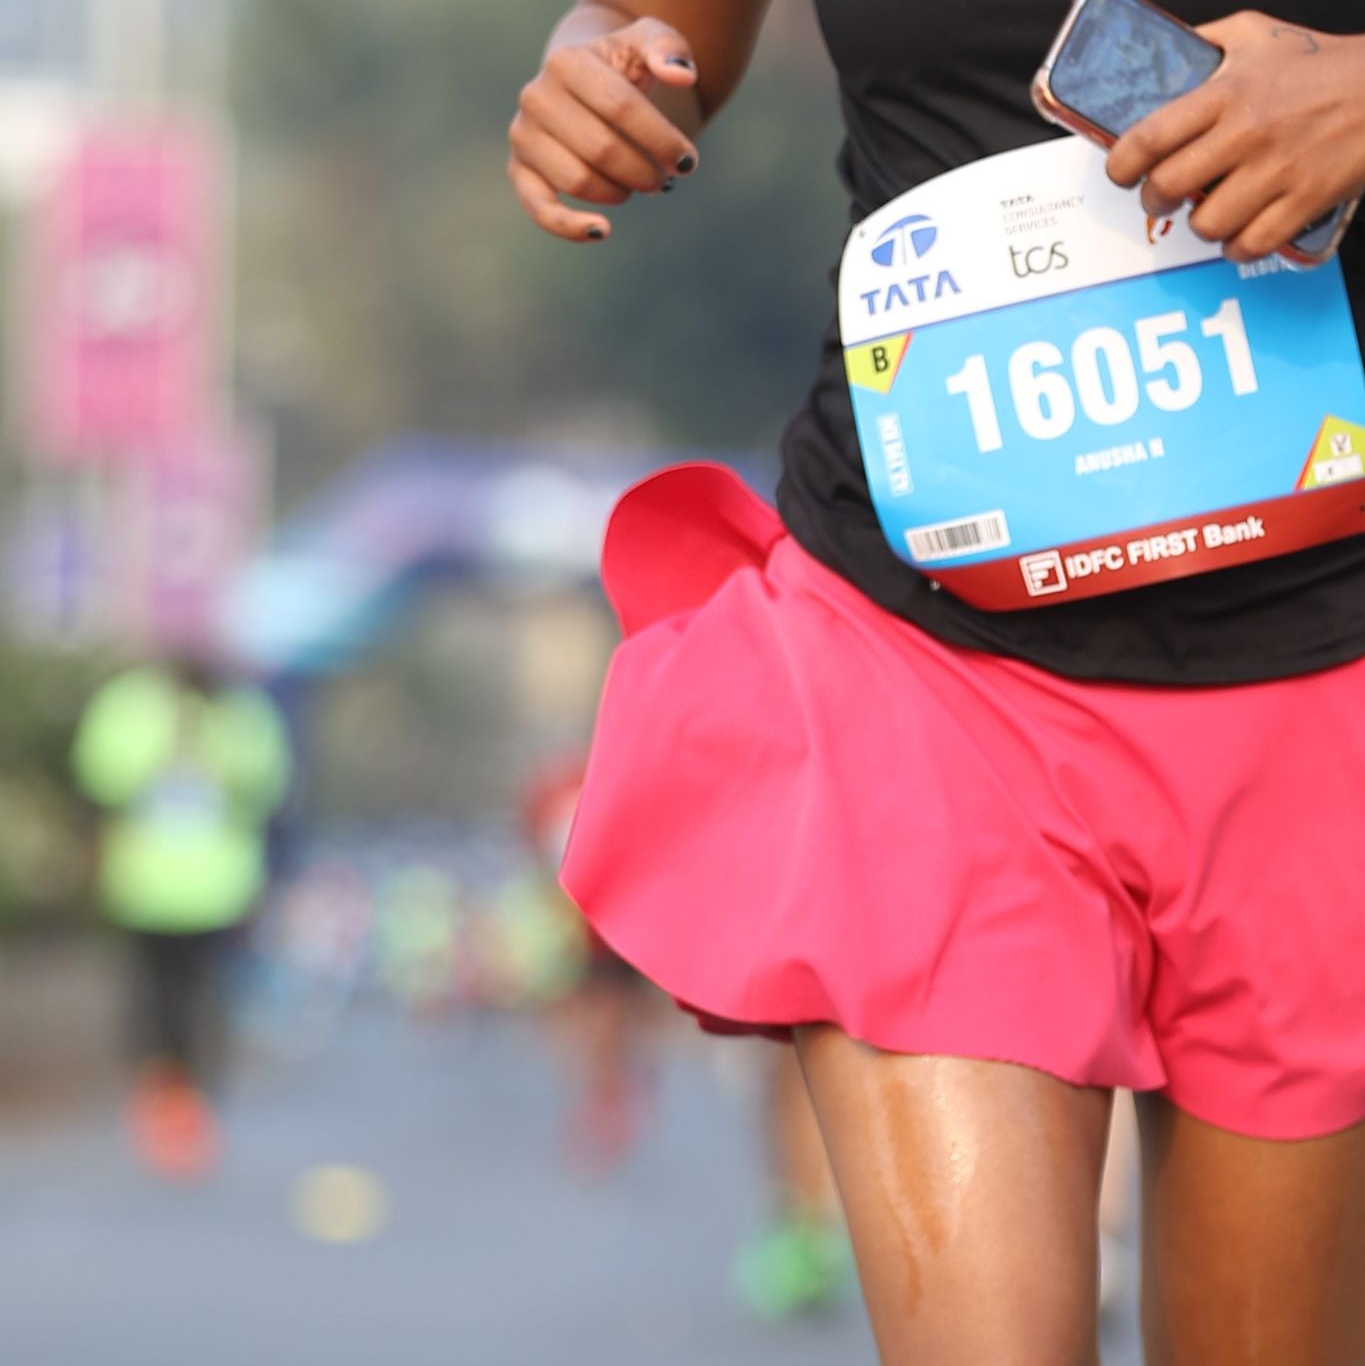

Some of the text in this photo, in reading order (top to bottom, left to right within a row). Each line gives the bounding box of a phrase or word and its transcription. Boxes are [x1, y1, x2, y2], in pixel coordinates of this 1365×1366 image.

[1009, 240, 1069, 278] tcs
[860, 270, 962, 316] TATA
[871, 345, 890, 374] B
[945, 296, 1259, 453] 16051
[1064, 515, 1266, 580] IDFC FIRST Bank
